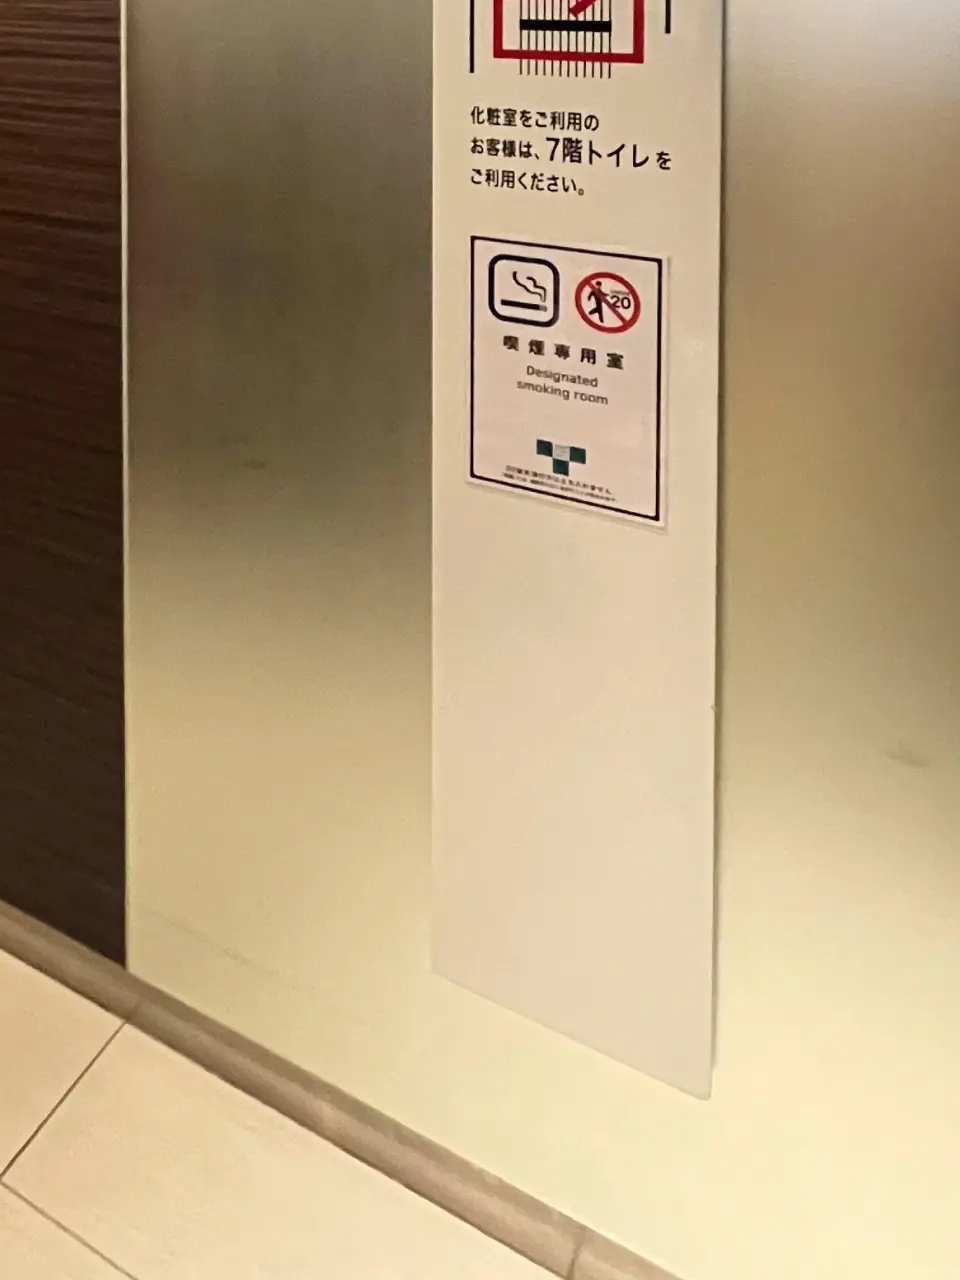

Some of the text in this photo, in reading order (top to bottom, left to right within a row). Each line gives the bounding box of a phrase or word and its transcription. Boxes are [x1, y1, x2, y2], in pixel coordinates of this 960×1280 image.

[470, 106, 600, 132] 化粧室をご利用の
[470, 168, 585, 196] ご利用ください。
[610, 295, 631, 310] 20
[526, 365, 599, 388] Designated
[517, 379, 609, 406] smoking room
